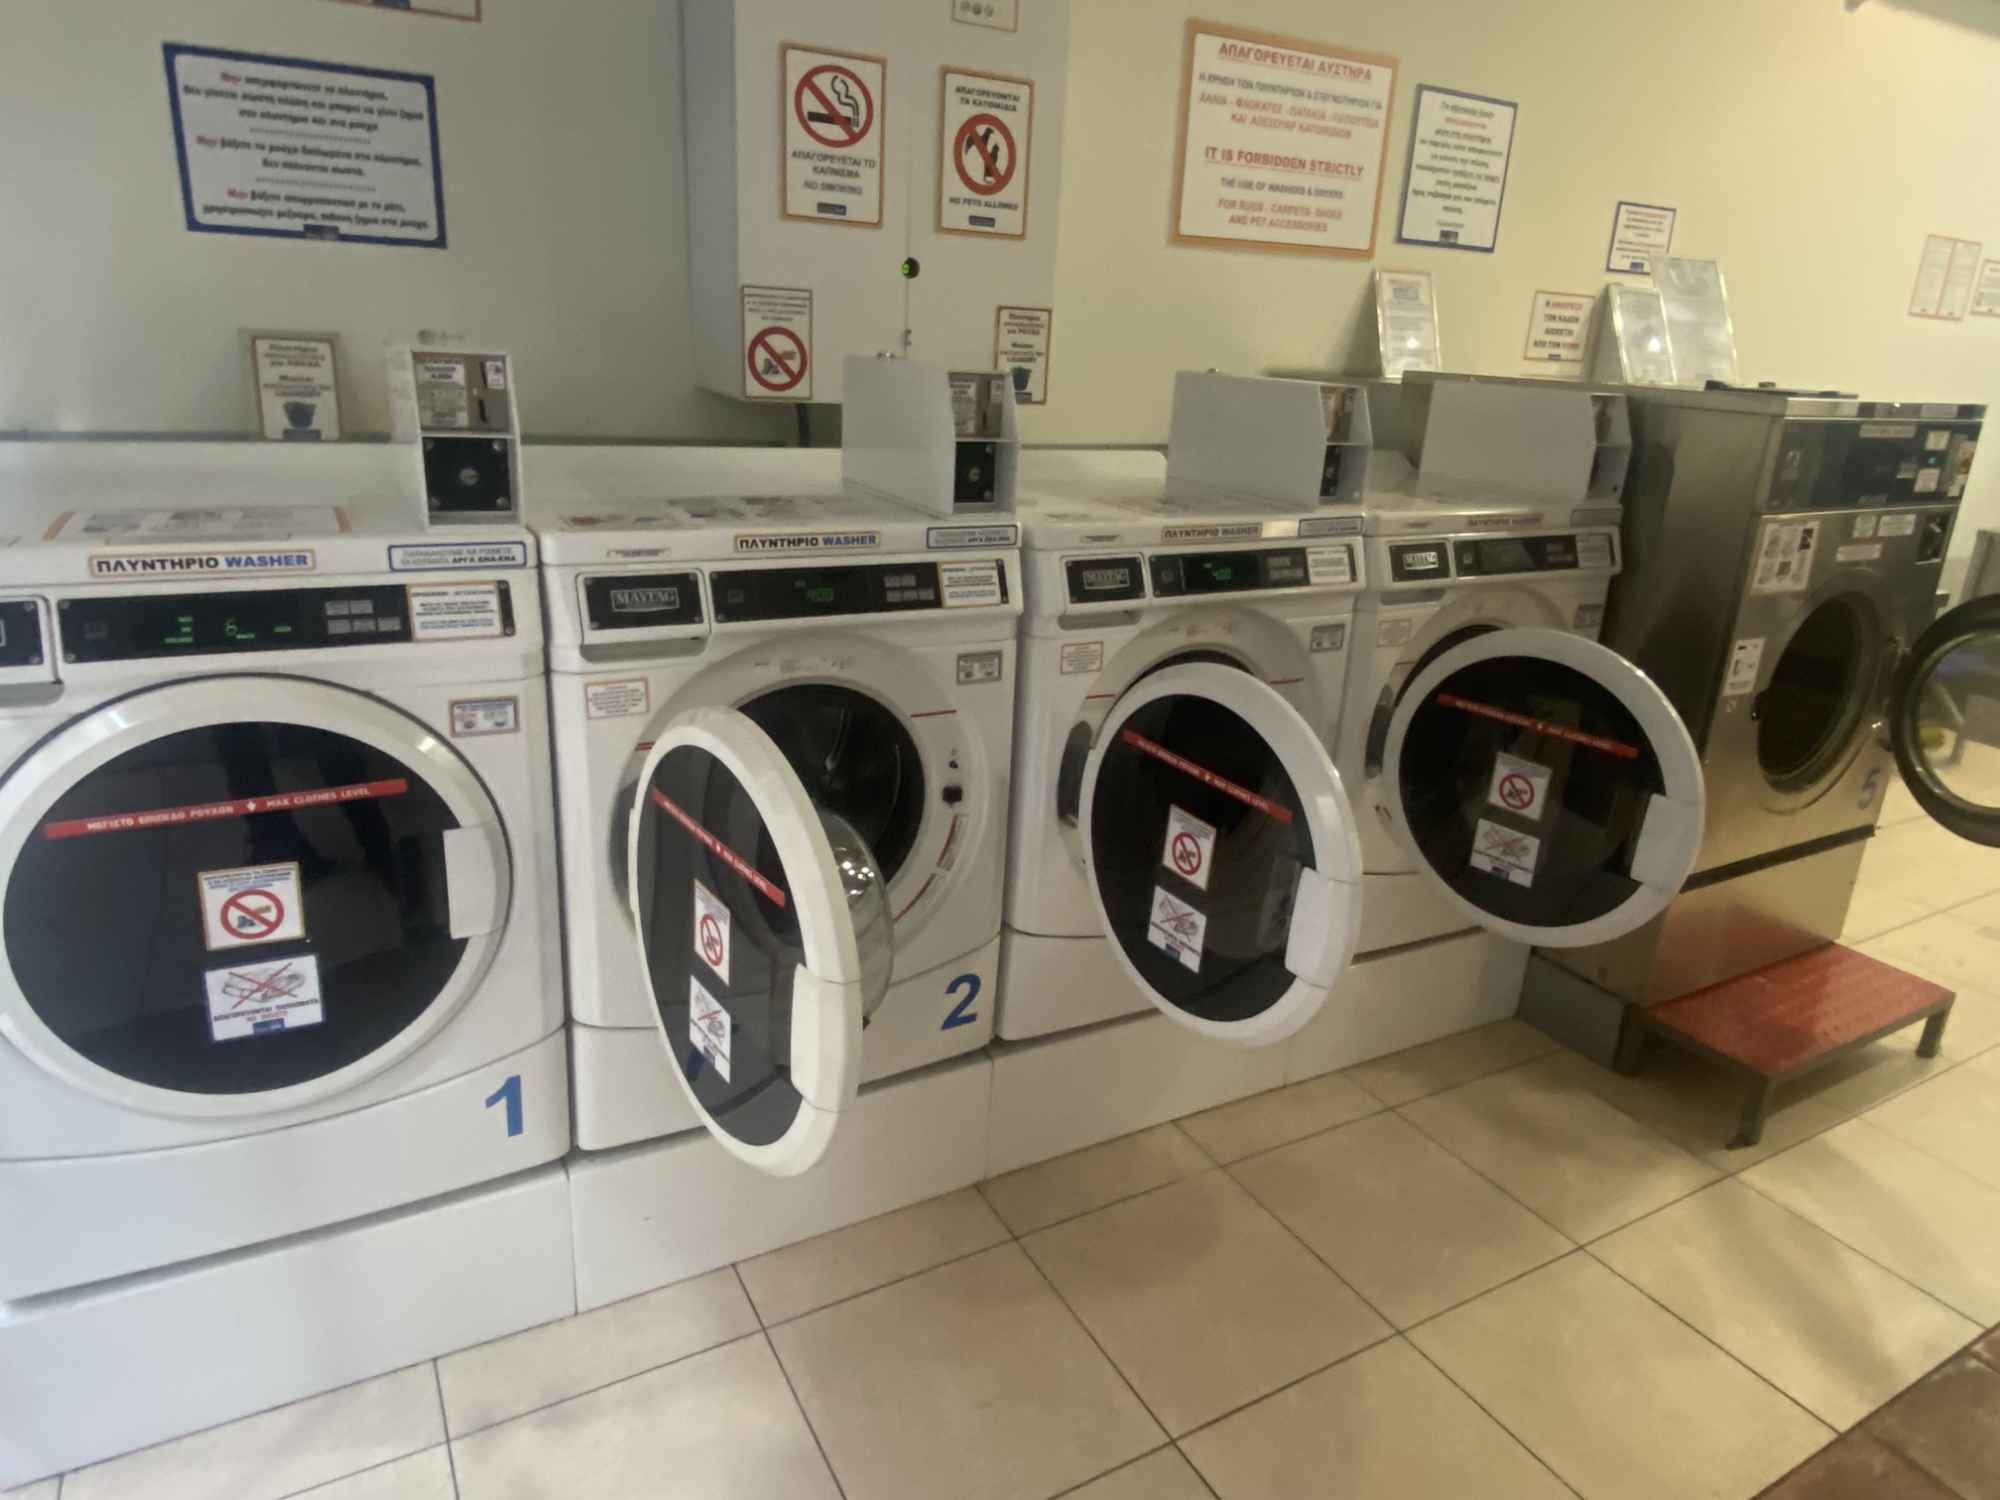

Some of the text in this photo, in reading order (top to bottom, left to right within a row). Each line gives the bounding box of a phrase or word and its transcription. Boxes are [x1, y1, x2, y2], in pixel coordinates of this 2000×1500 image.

[1218, 42, 1373, 81] ΑΠΑΓΟΡΕΥΕΤΑΙ ΑΥΣΤΗΡΑ
[792, 149, 861, 169] ΑΠΑΓΟΡΕΥΕΤΑΙ
[1205, 145, 1364, 177] IT IS FORBIDDEN STRICTLY
[738, 534, 877, 551] ΠΛΥΝΤΗΡΙΟ WASHER
[97, 554, 309, 574] ΠΛΥΝΤΗΡΙΟ WASHER
[613, 589, 678, 606] MAYTAG
[266, 798, 291, 809] MAX
[293, 791, 338, 806] CLOTHES
[340, 787, 370, 800] LEVEL
[941, 973, 981, 1031] 2
[485, 1074, 524, 1138] 1
